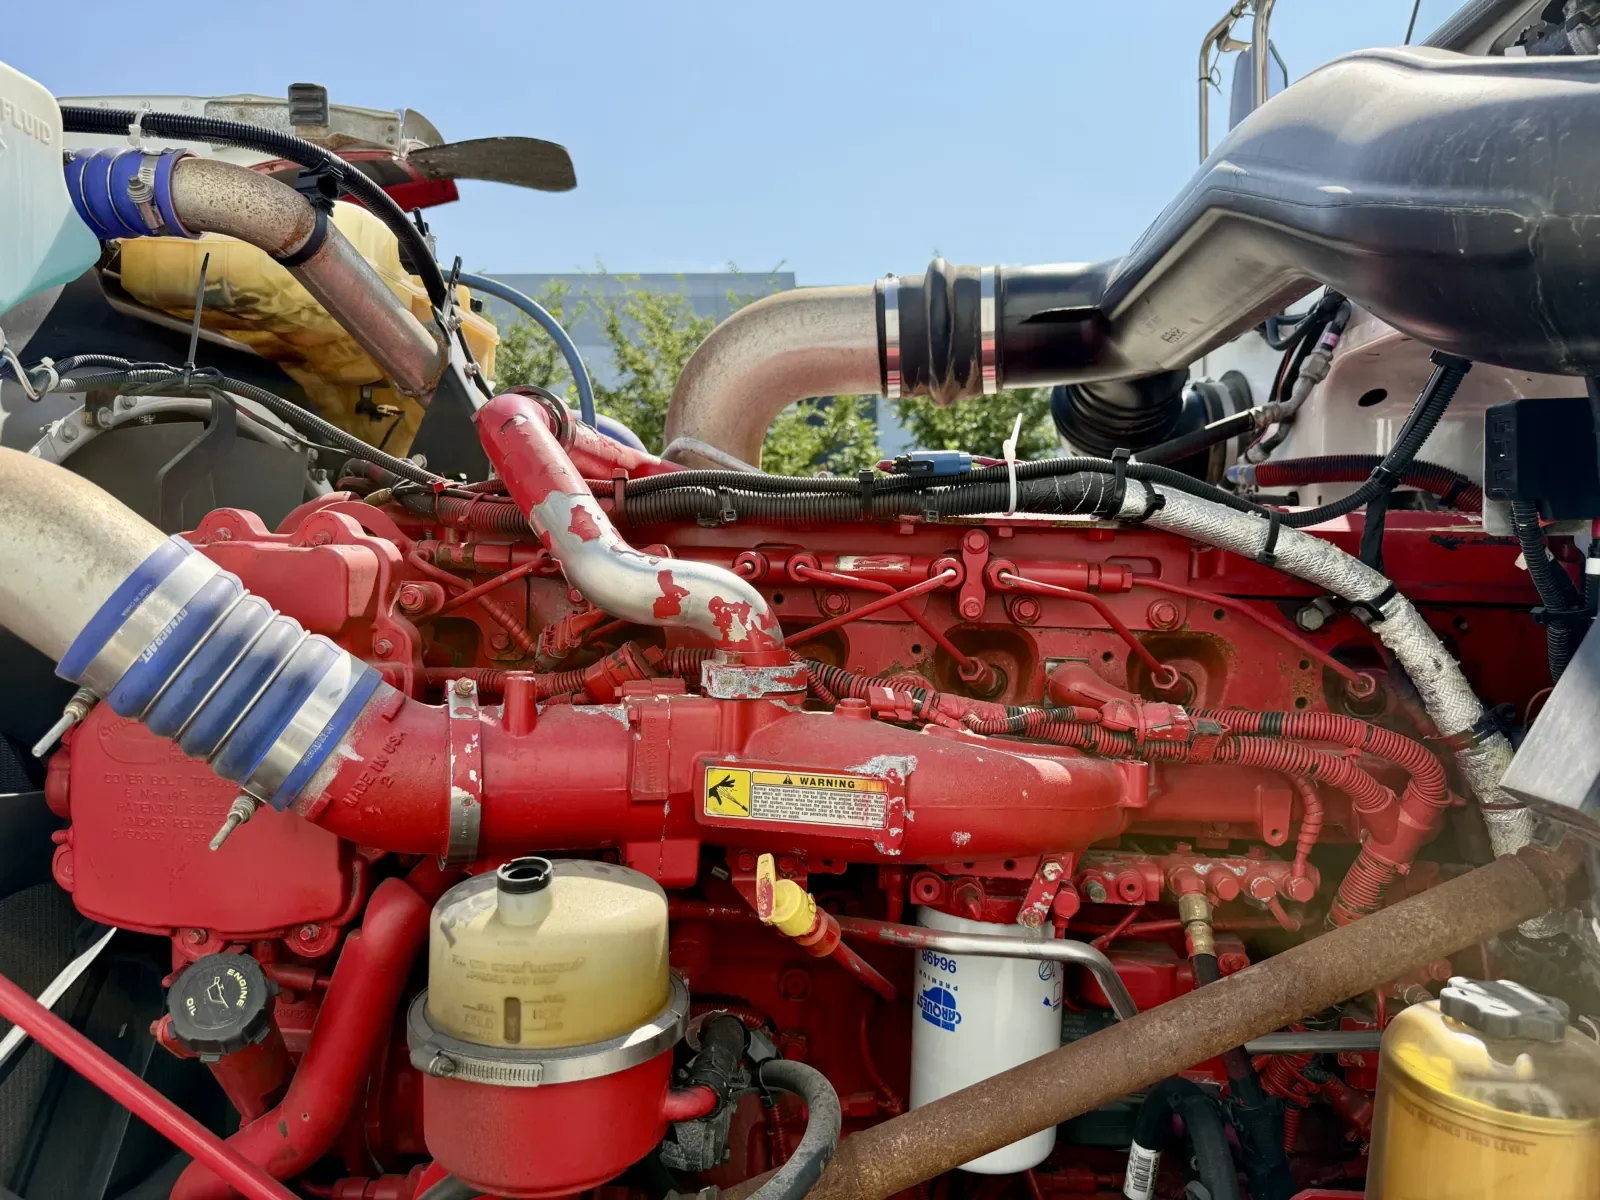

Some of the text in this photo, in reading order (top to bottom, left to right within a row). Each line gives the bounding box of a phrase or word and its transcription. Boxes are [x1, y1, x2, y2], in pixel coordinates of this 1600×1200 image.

[0, 97, 52, 146] FLUID
[142, 608, 188, 664] DYNACRAFT
[342, 732, 408, 808] MADE IN USA
[800, 776, 855, 788] WARNING
[226, 968, 248, 1007] ENGINE
[919, 968, 958, 991] PREMIUM
[186, 998, 198, 1016] OIL
[917, 992, 962, 1024] CARQUEST
